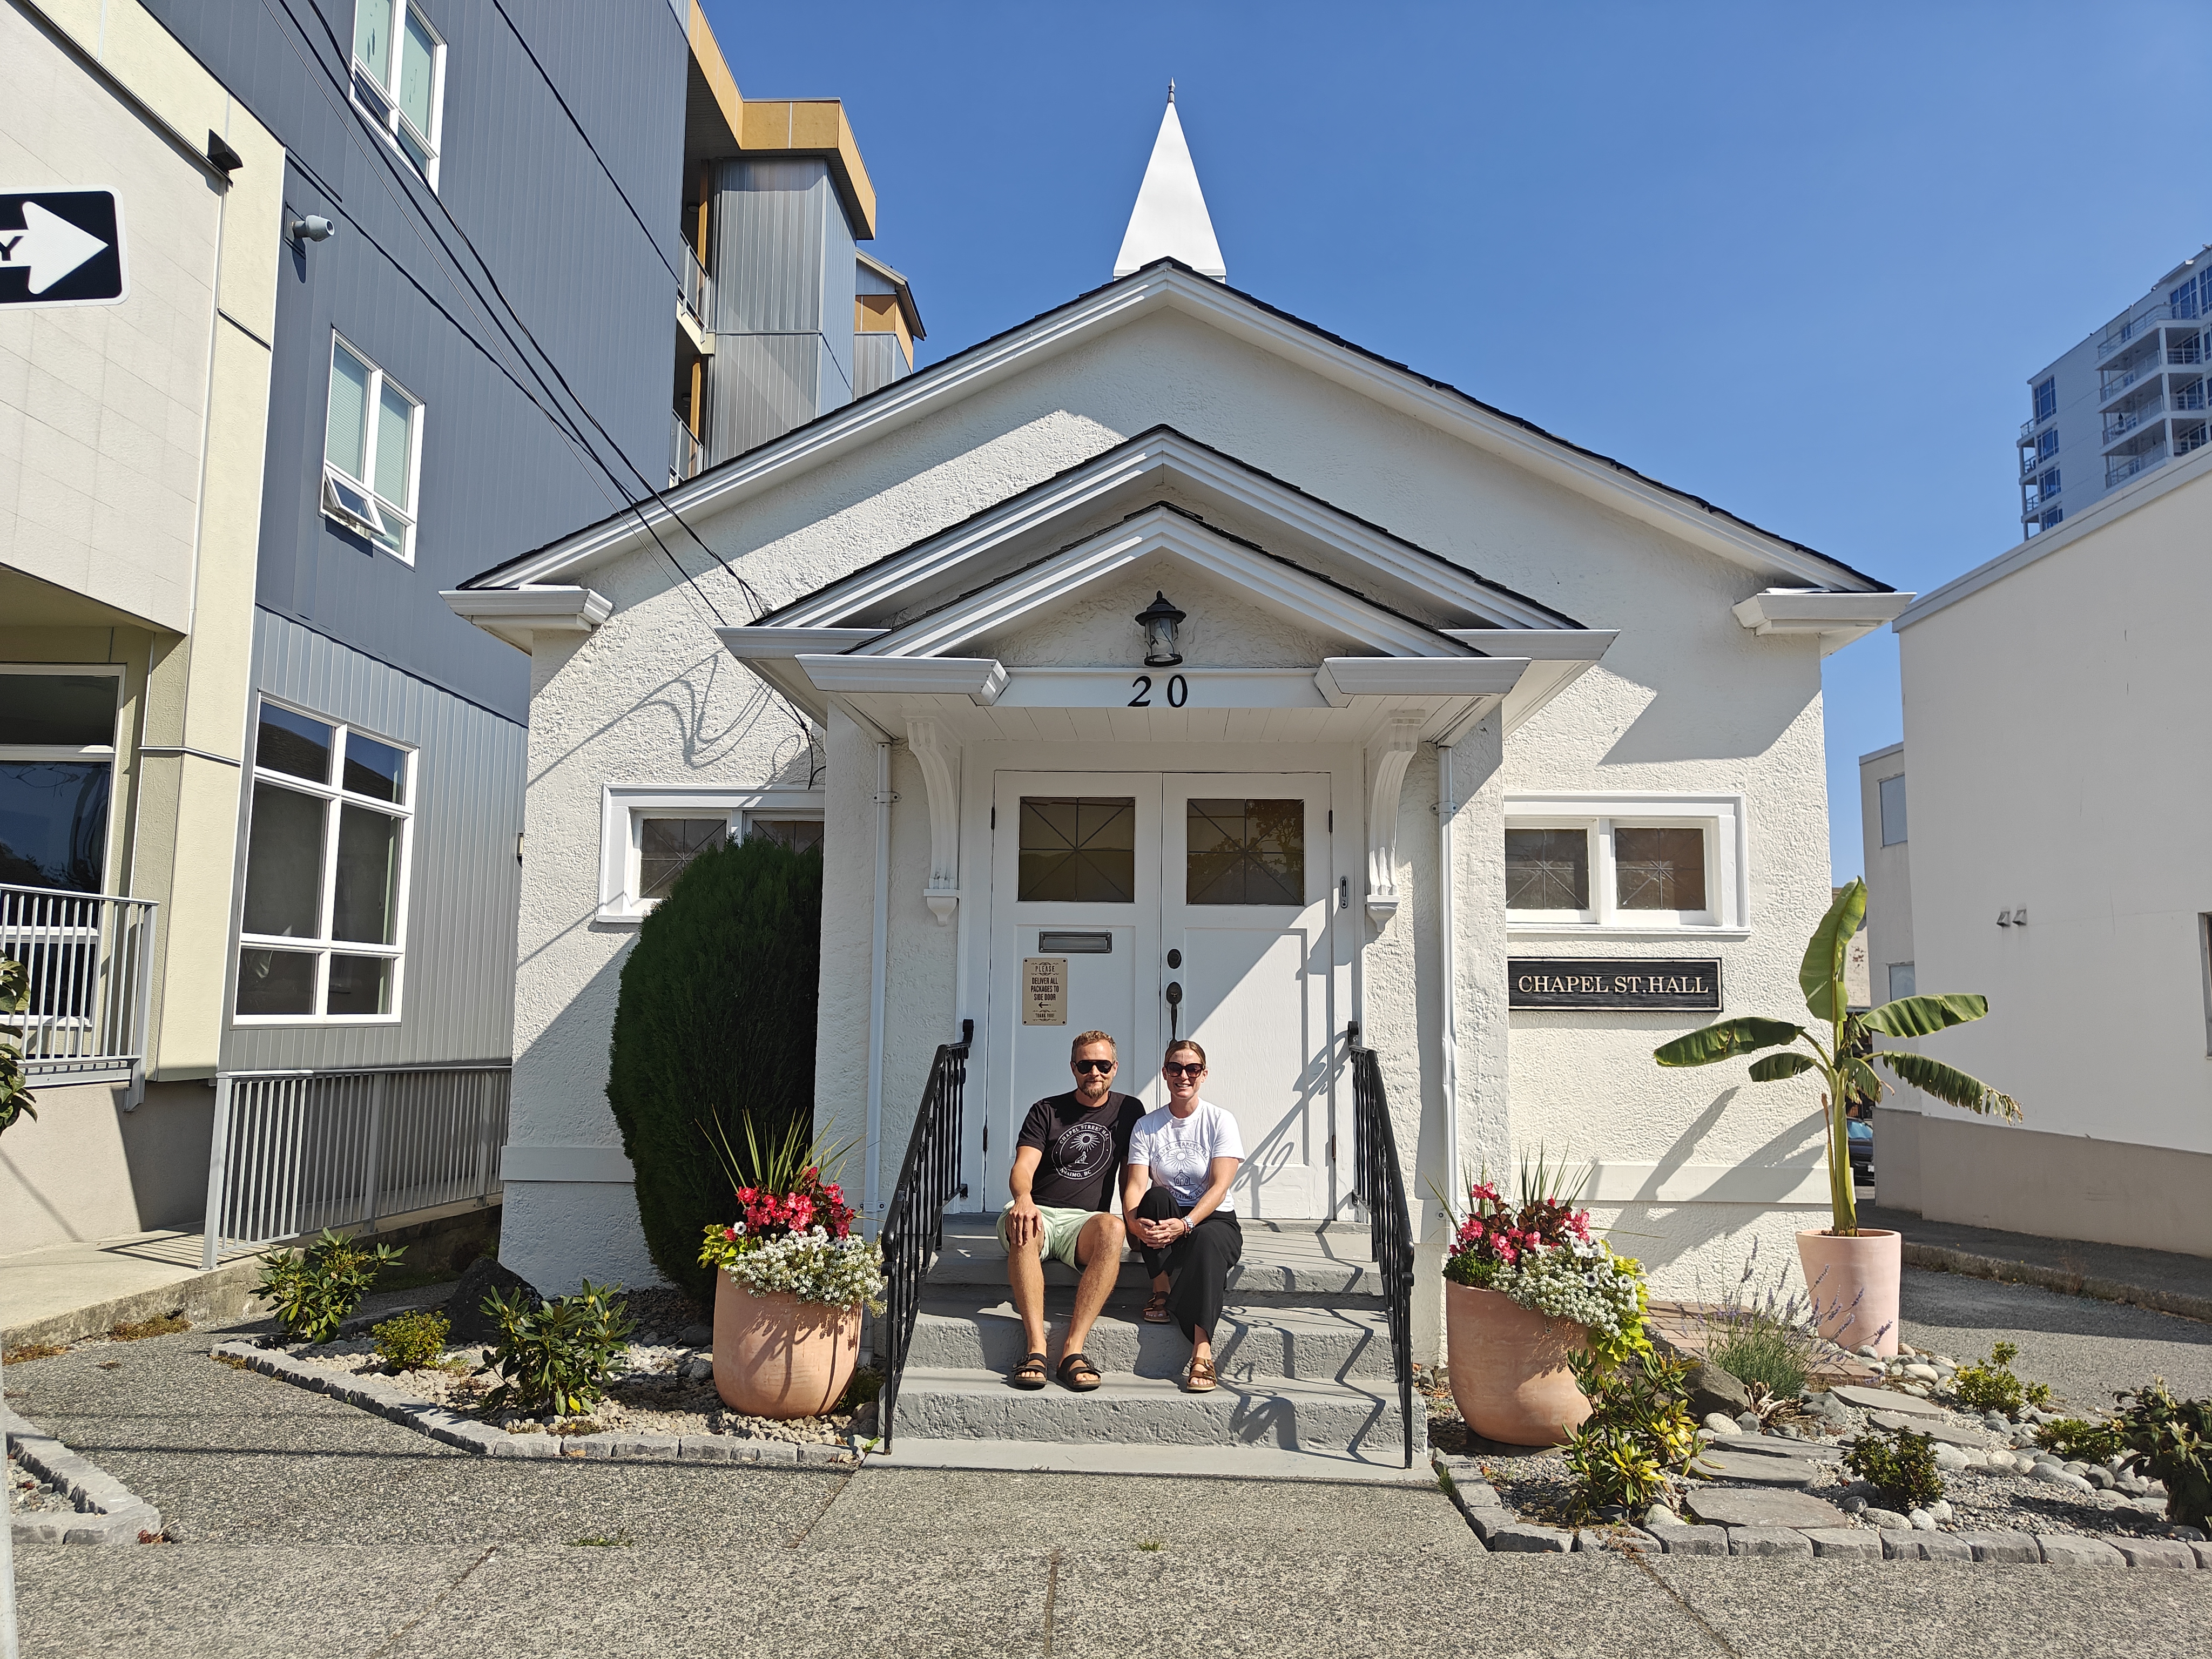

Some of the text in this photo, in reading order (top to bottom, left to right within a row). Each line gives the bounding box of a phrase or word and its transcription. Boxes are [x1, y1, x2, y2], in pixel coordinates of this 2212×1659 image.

[1127, 675, 1188, 707] 20
[1518, 975, 1608, 993] CHAPEL
[1060, 1128, 1080, 1144] CHAPEL
